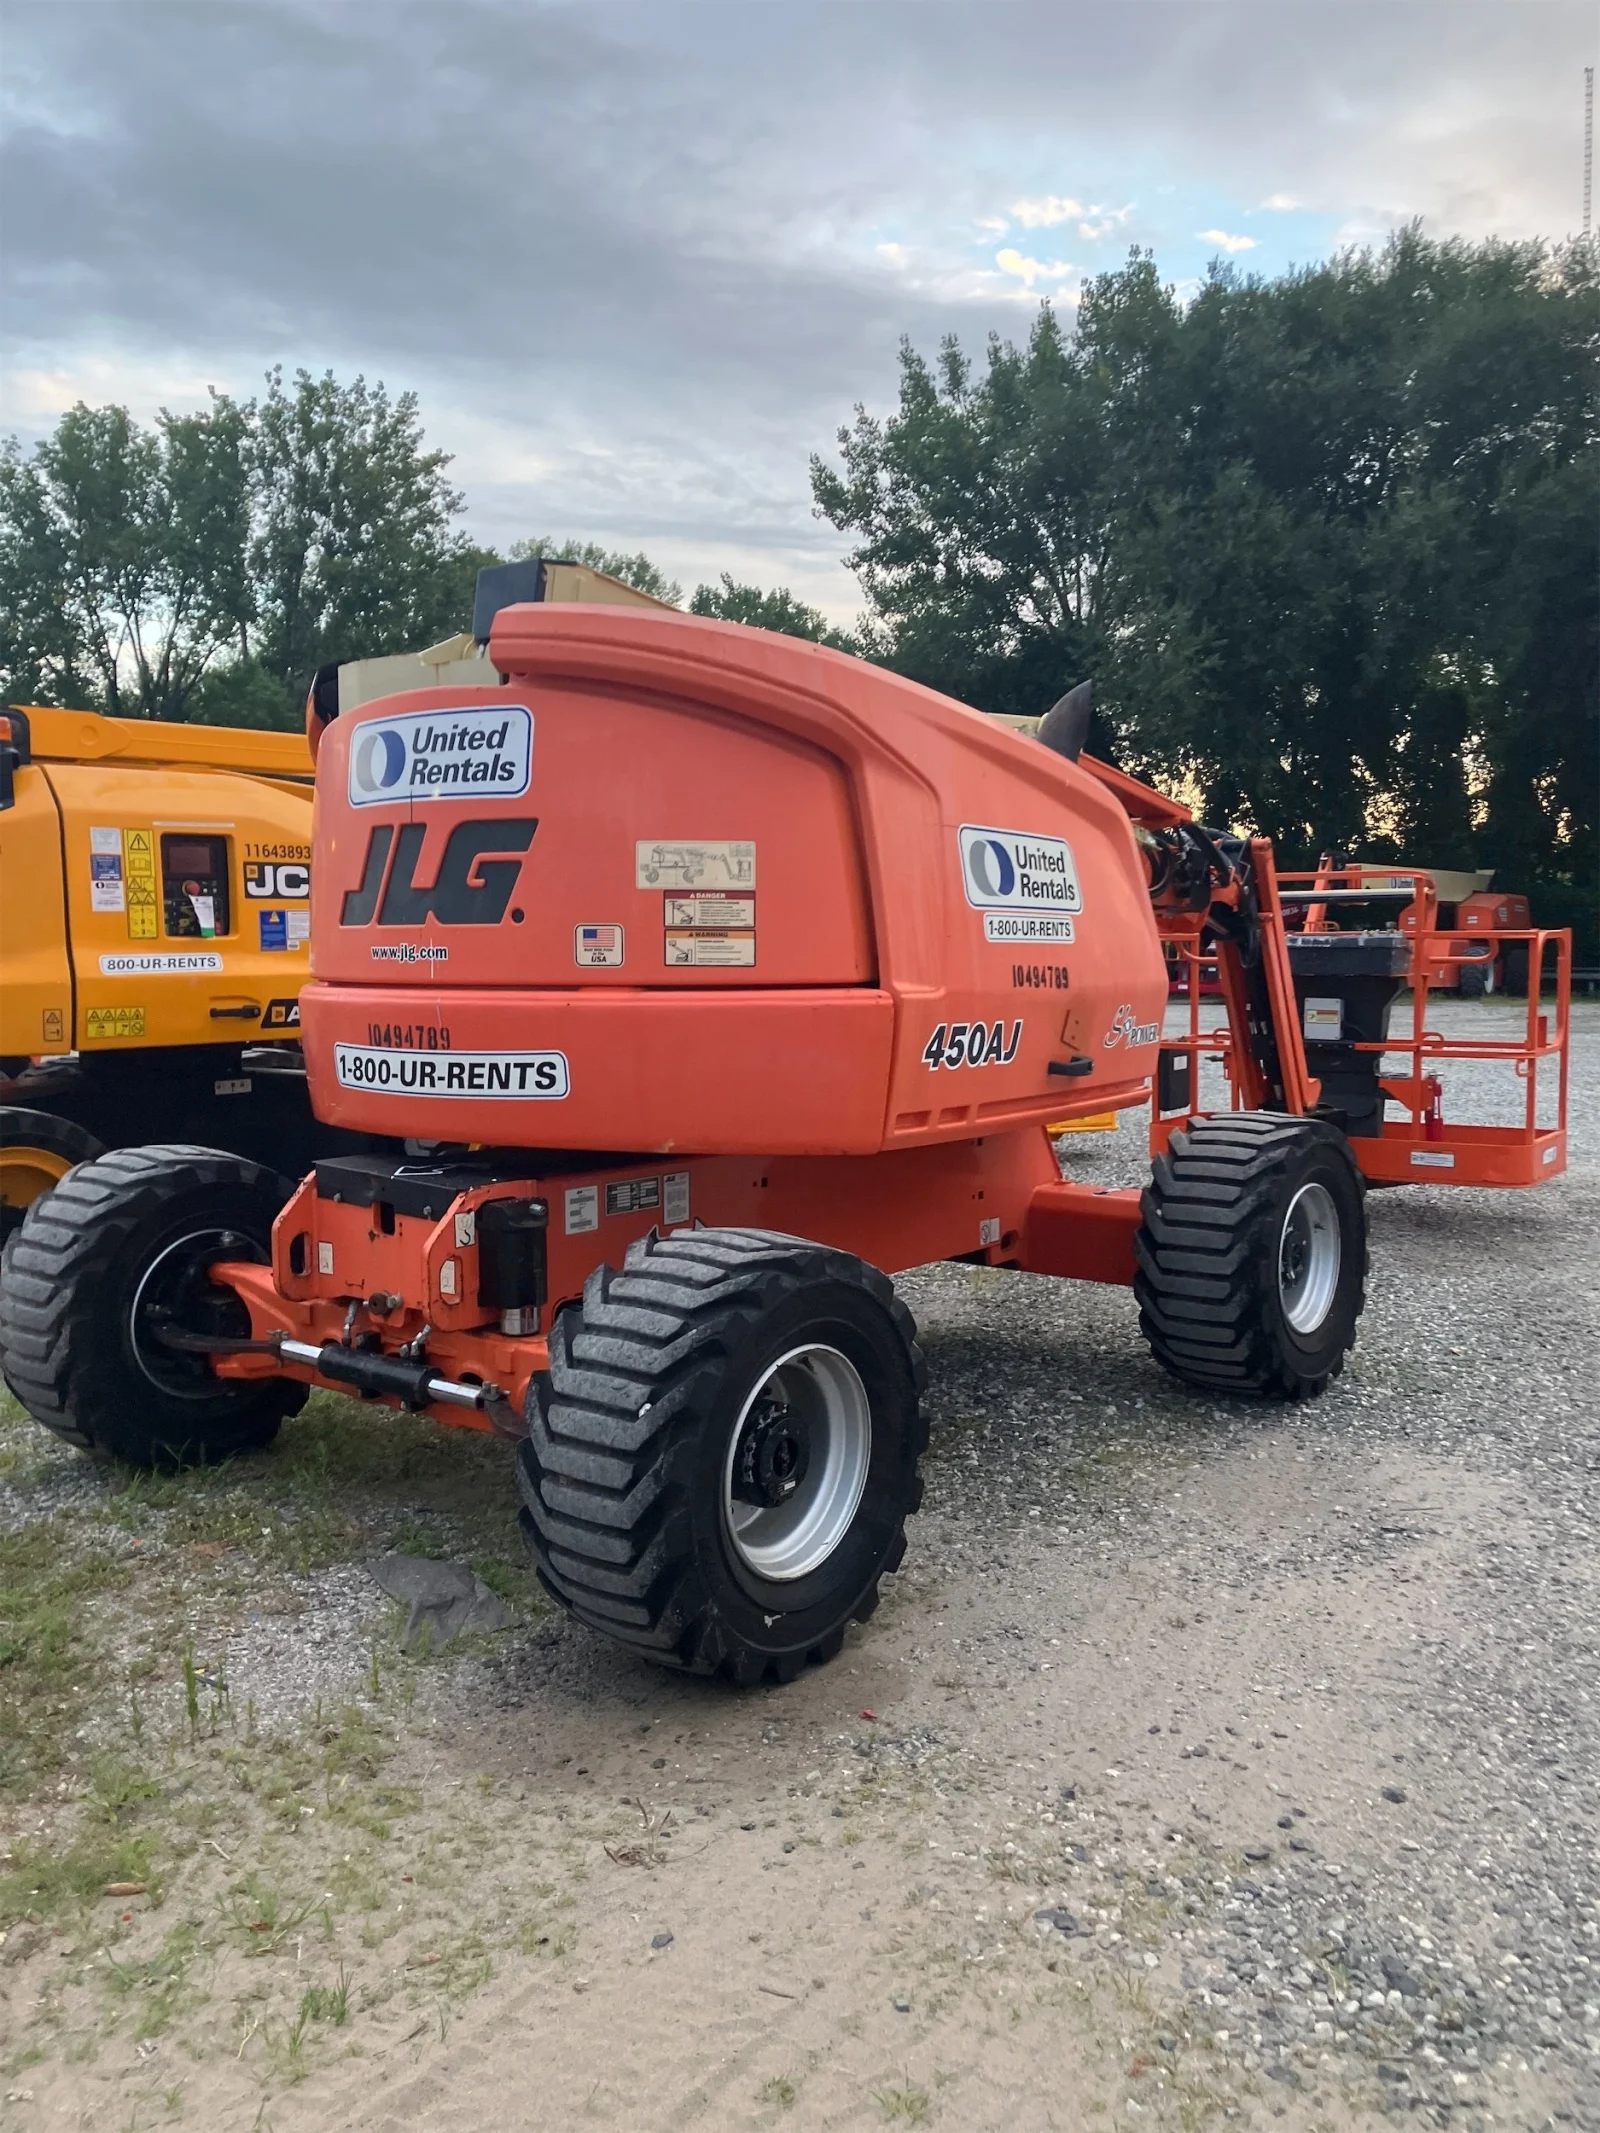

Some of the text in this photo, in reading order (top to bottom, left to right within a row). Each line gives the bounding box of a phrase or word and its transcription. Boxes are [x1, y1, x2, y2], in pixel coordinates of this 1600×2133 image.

[412, 721, 510, 754] United
[409, 754, 516, 786] Rentals
[245, 843, 311, 859] 11643893
[1015, 844, 1066, 874] United
[1020, 873, 1076, 901] Rentals
[988, 920, 1071, 937] 1-800-UR-RENTS
[107, 957, 217, 971] 800-UR-RENTS
[371, 943, 448, 962] www.jlg.com
[591, 955, 607, 963] USA
[1012, 964, 1069, 989] 10494789
[921, 1019, 1023, 1071] 450AJ
[339, 1053, 558, 1091] 1-800-UR-RENTS
